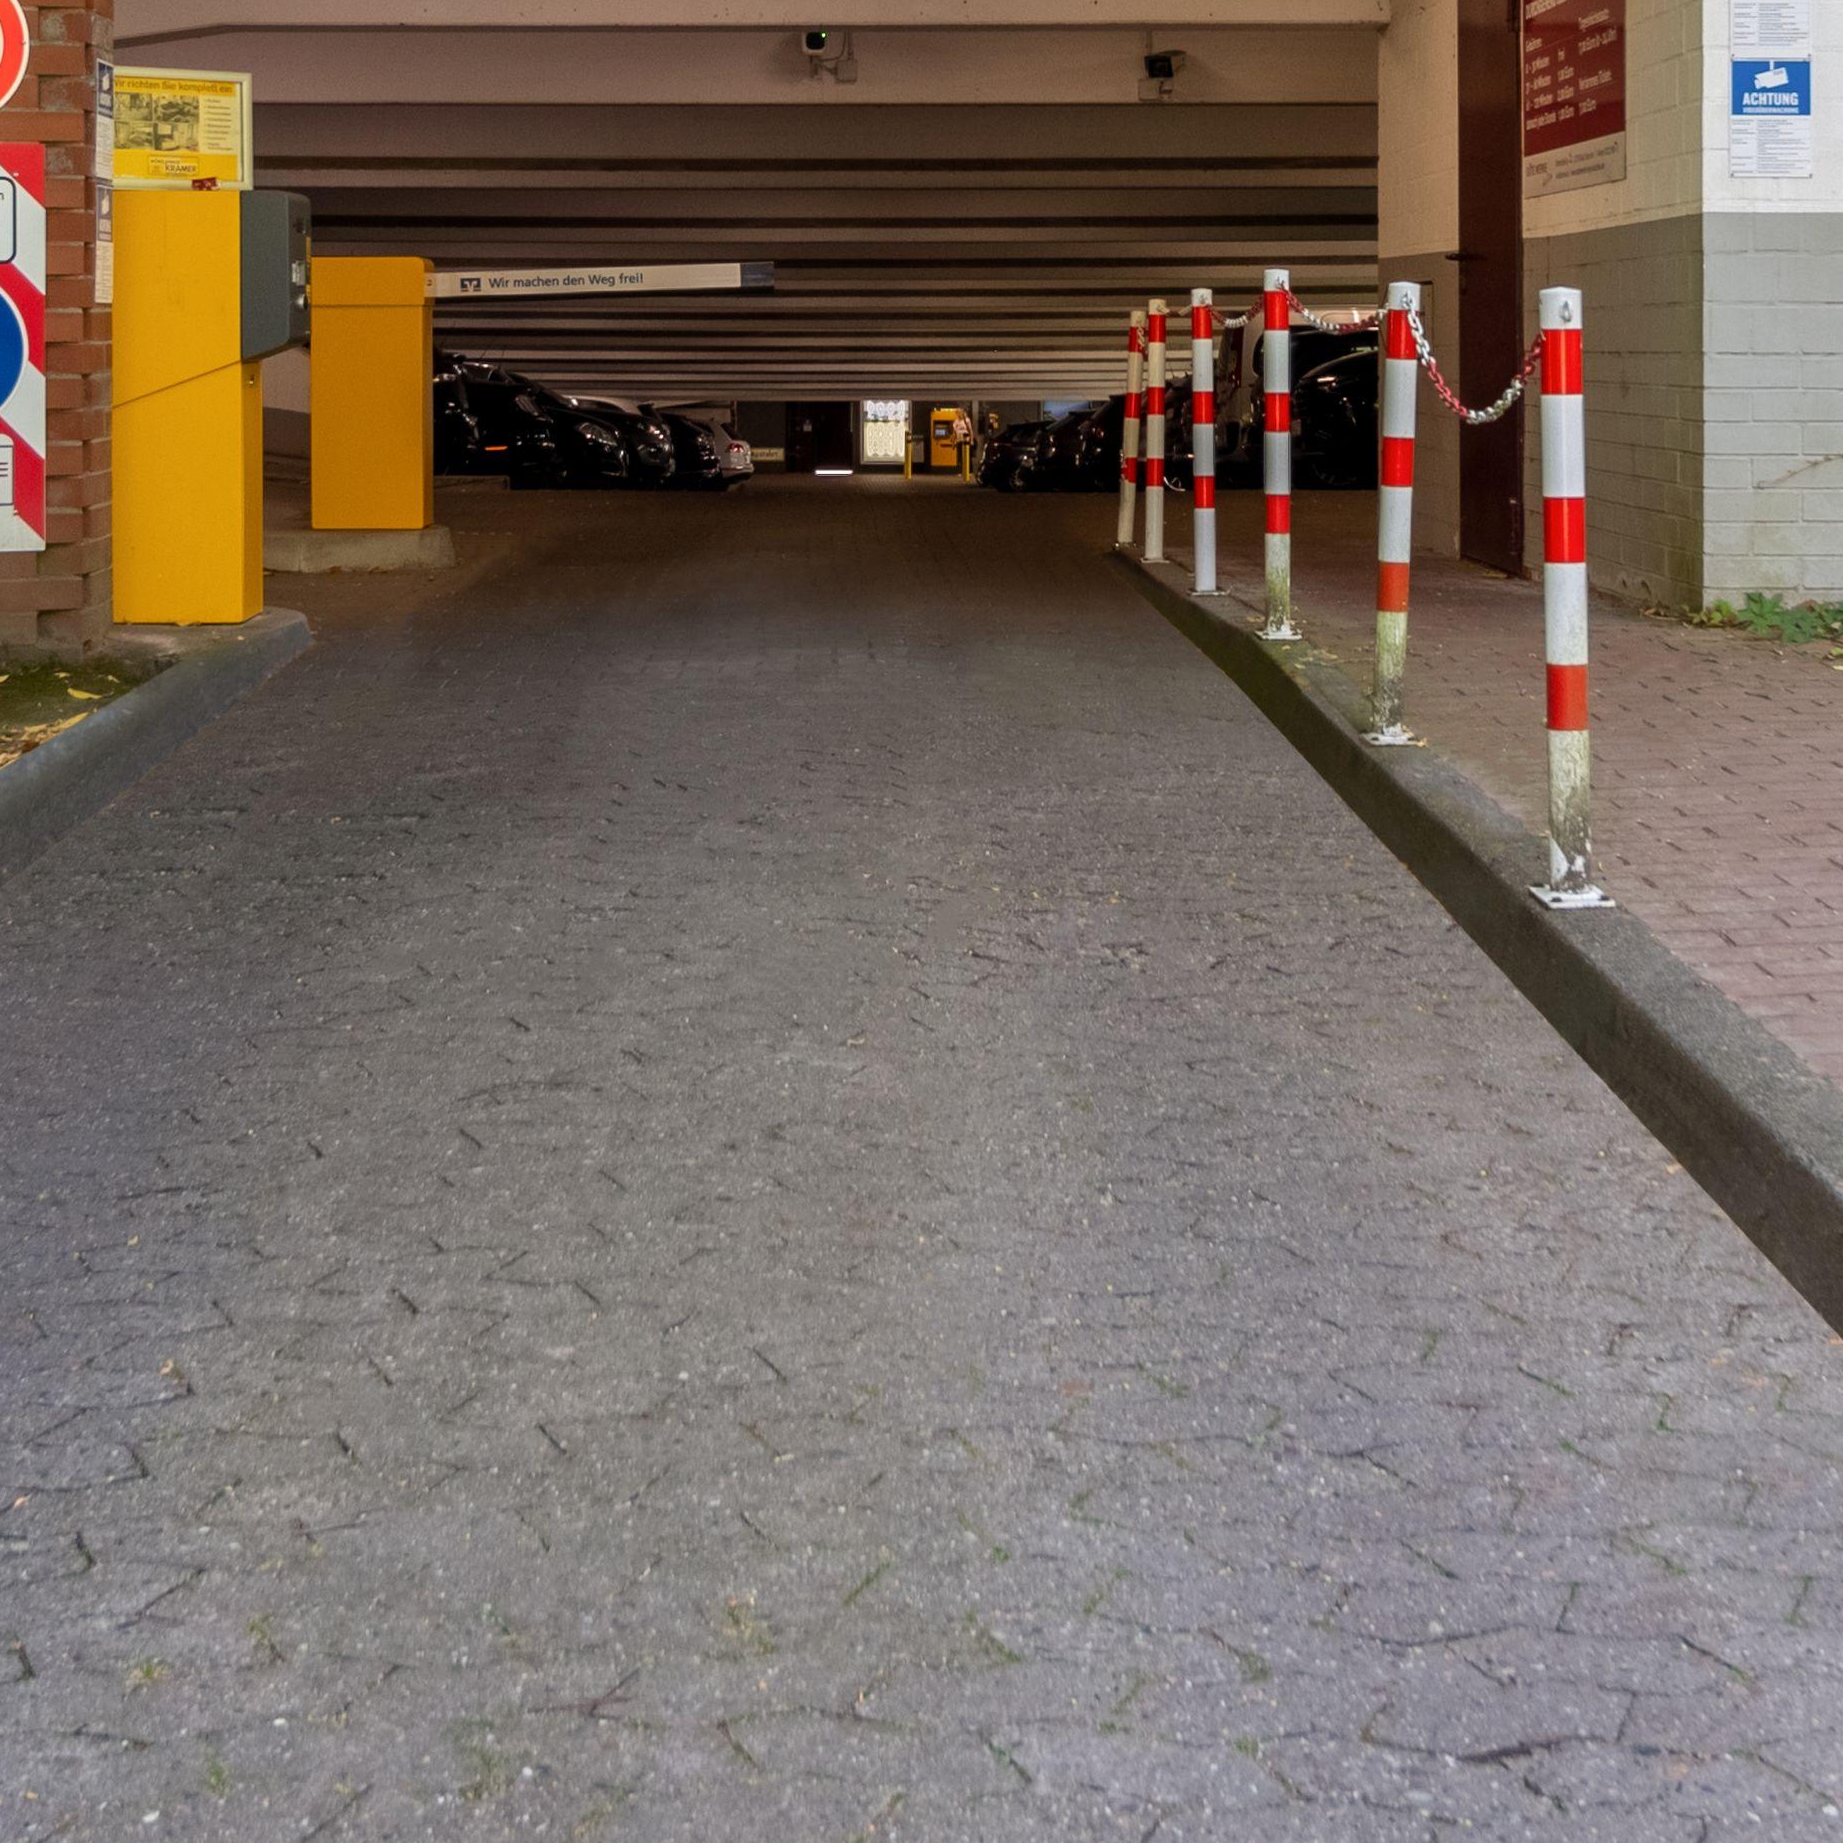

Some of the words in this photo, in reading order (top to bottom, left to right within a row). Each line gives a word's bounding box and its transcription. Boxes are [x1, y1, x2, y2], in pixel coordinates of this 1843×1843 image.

[1743, 92, 1798, 105] ACHTUNG
[488, 277, 509, 288] Wir
[513, 276, 559, 288] machen
[563, 275, 585, 286] den
[588, 274, 615, 286] Weg
[619, 273, 643, 284] frei!
